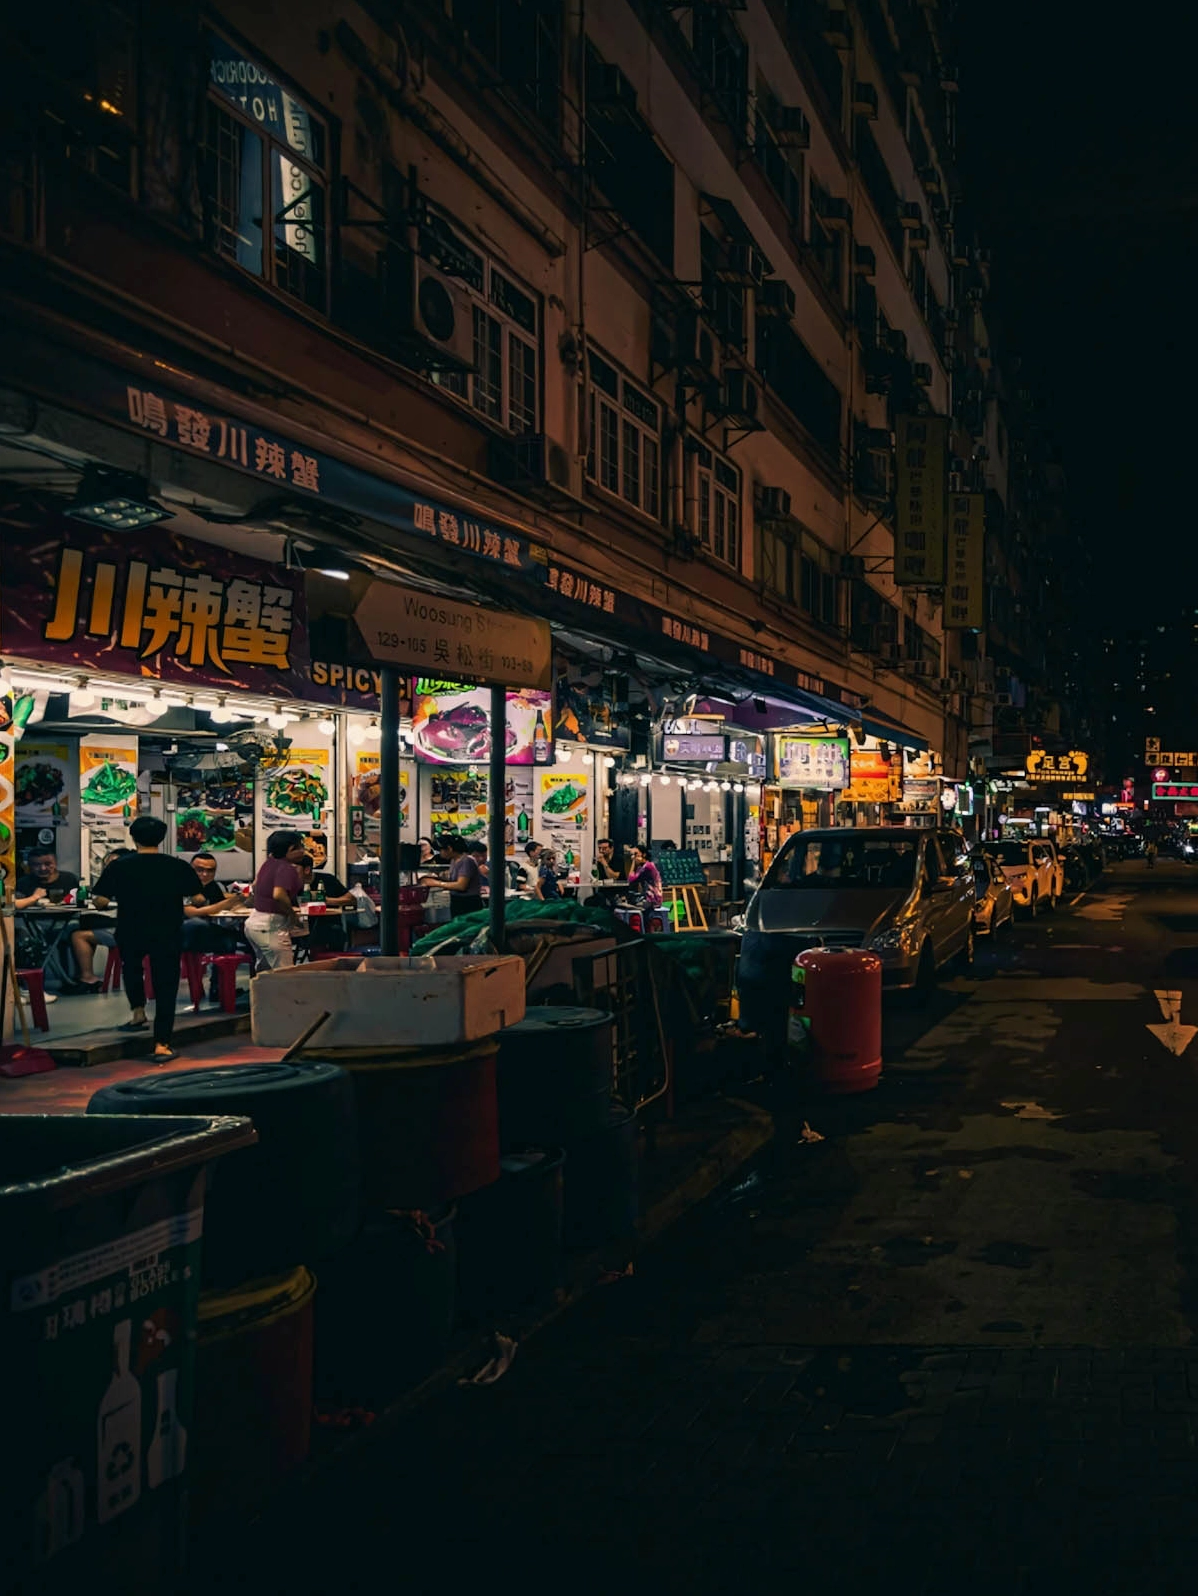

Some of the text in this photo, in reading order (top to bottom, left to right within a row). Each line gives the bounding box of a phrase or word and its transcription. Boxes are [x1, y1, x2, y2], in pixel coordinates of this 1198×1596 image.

[126, 385, 320, 494] 鳴發川辣蟹
[44, 547, 295, 675] 川辣蟹
[403, 596, 472, 634] Woosung
[433, 638, 494, 672] 吳松街
[312, 660, 382, 695] SPICY
